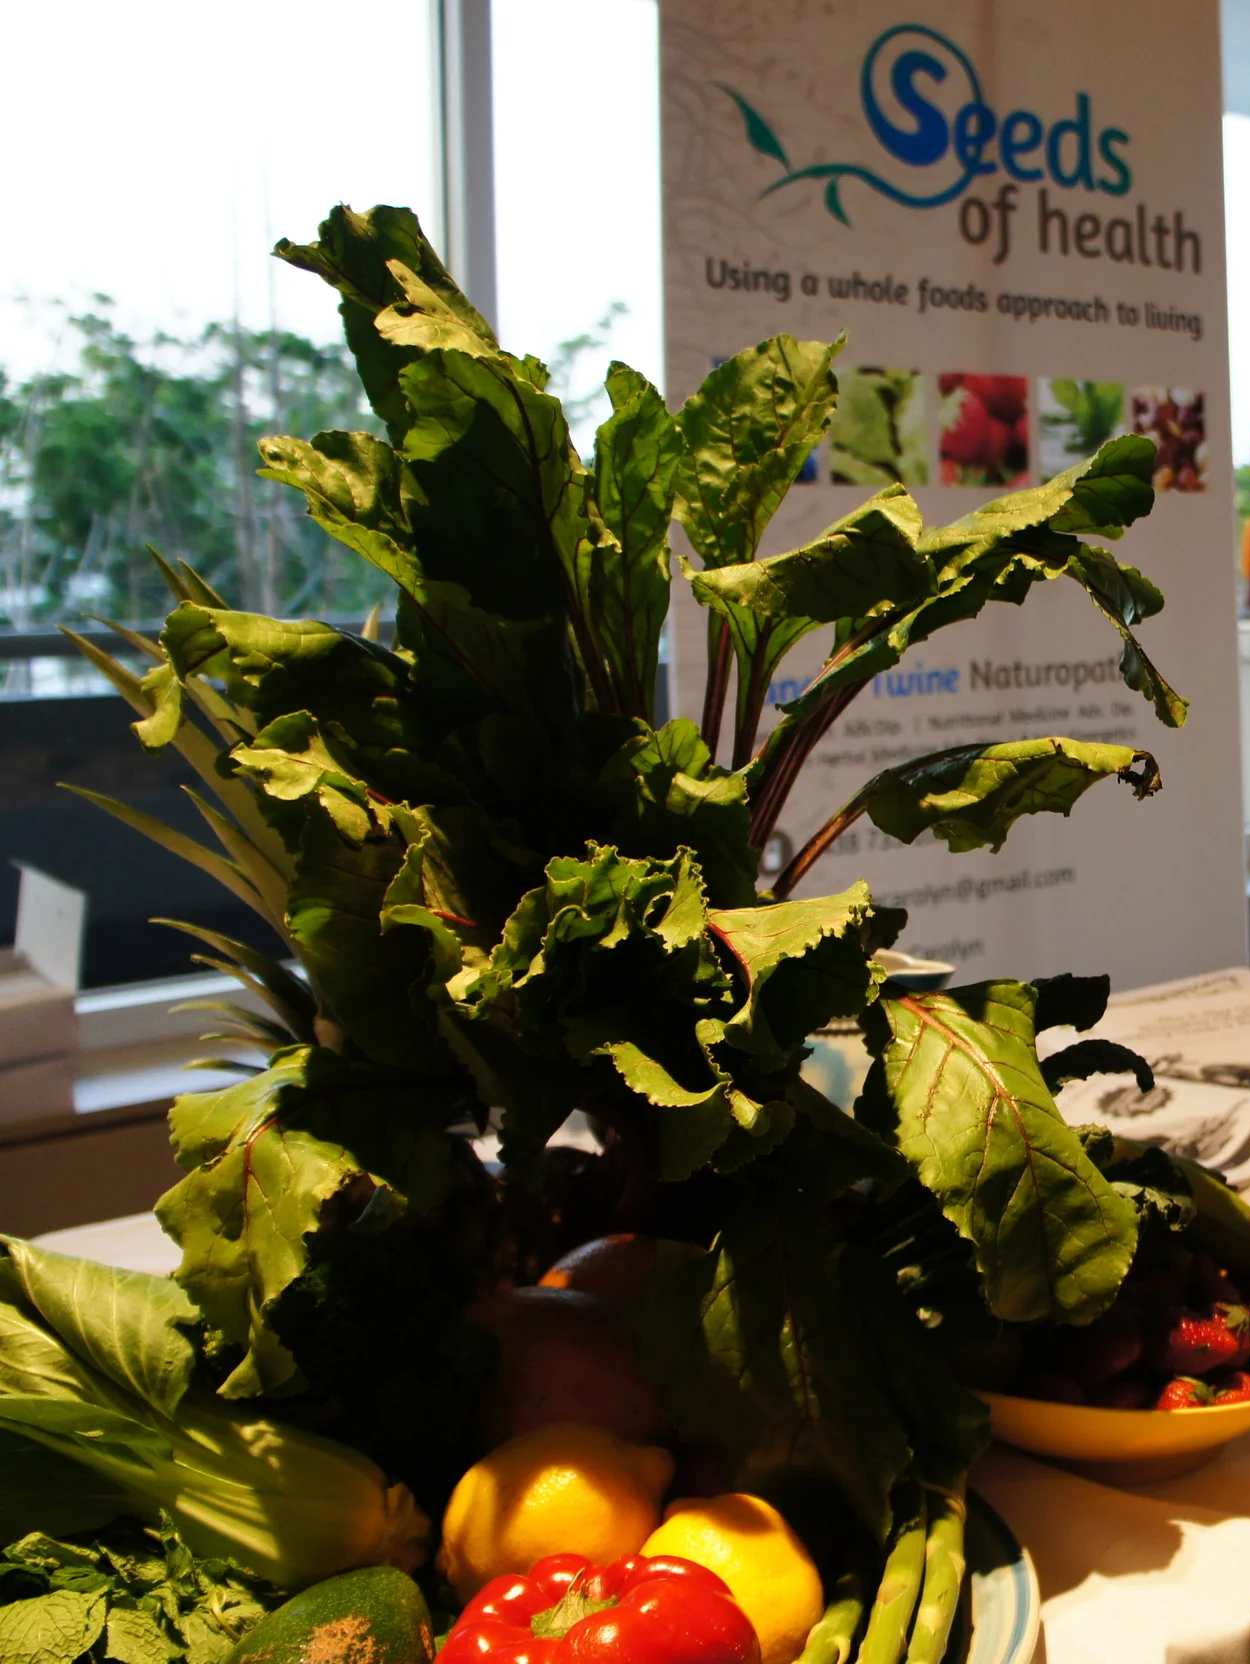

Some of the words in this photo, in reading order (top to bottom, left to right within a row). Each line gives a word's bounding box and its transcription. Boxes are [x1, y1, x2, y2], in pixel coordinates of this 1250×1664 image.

[888, 50, 1132, 197] Seeds
[958, 183, 1019, 266] of
[1036, 187, 1203, 275] health
[705, 257, 791, 302] Using
[800, 273, 819, 296] a
[828, 270, 909, 306] whole
[917, 276, 989, 315] foods
[996, 291, 1111, 324] approach
[1116, 302, 1141, 327] to
[1144, 302, 1204, 342] living
